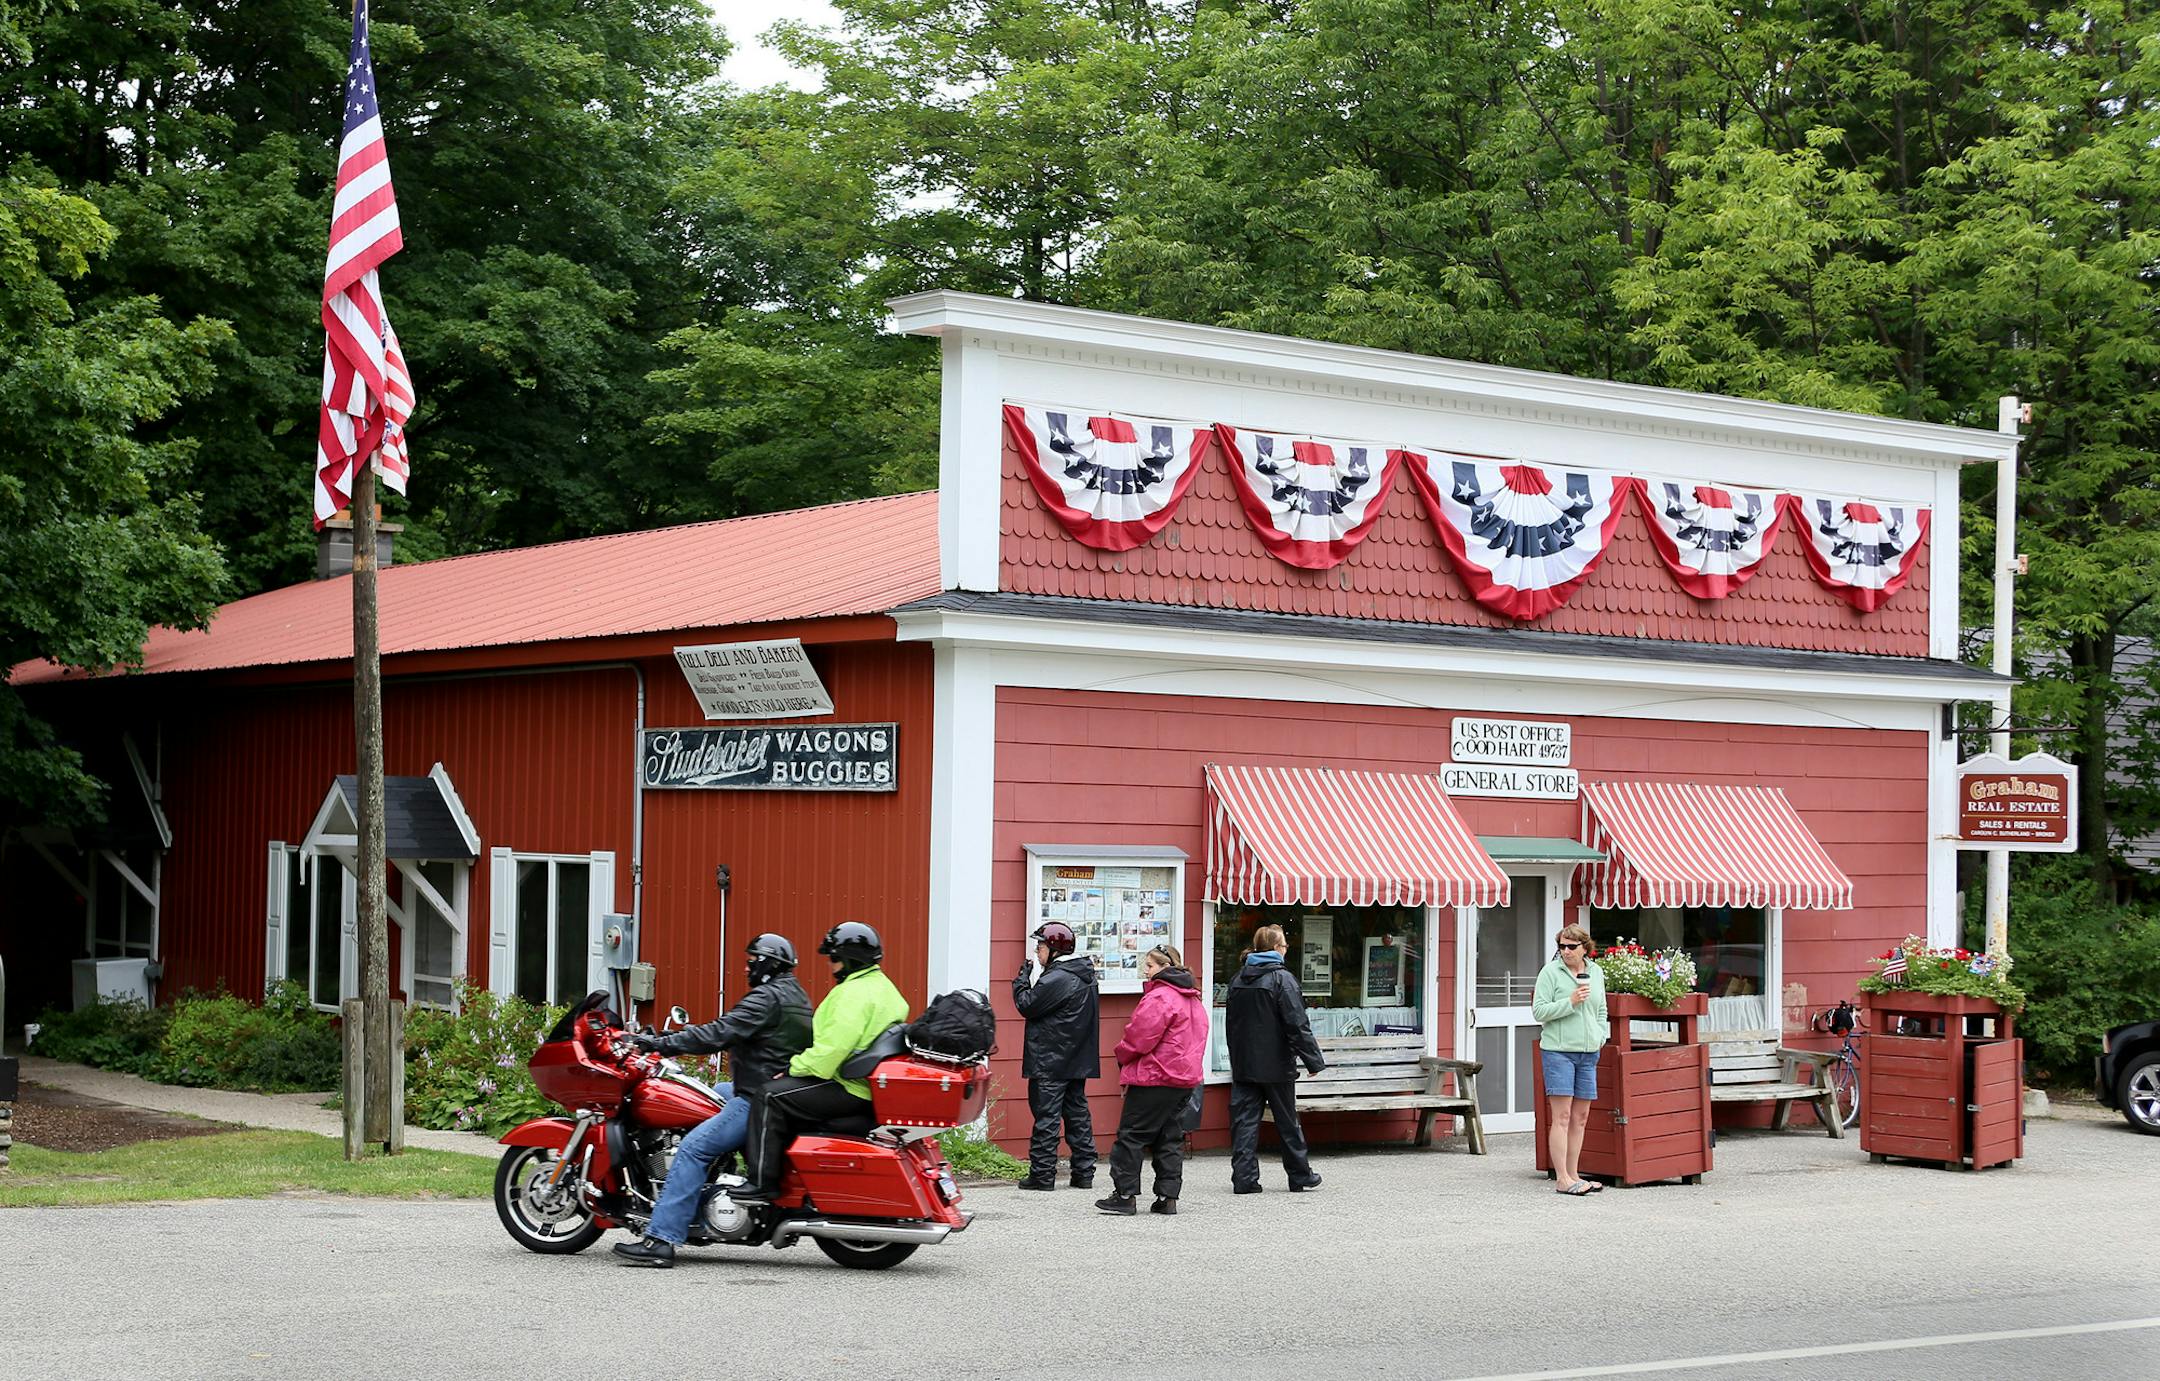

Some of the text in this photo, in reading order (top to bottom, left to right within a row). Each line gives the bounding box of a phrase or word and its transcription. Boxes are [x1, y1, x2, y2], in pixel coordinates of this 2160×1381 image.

[677, 645, 804, 669] FULL DELI AND BAKERY
[716, 697, 813, 714] GOOD EATS SOLD HERE
[776, 730, 888, 753] WAGONS
[1483, 723, 1517, 740] POST
[1520, 725, 1565, 742] OFFICE
[645, 730, 771, 785] Studebaker
[1498, 741, 1537, 758] HART
[1538, 743, 1569, 759] 49737
[772, 761, 891, 783] BUGGIES
[1444, 769, 1576, 793] GENERAL STORE
[1969, 776, 2059, 800] Graham
[1967, 801, 2060, 813] REAL ESTATE
[1979, 820, 2003, 829] SALES
[2013, 821, 2048, 830] RENTALS
[1056, 867, 1094, 879] Graham
